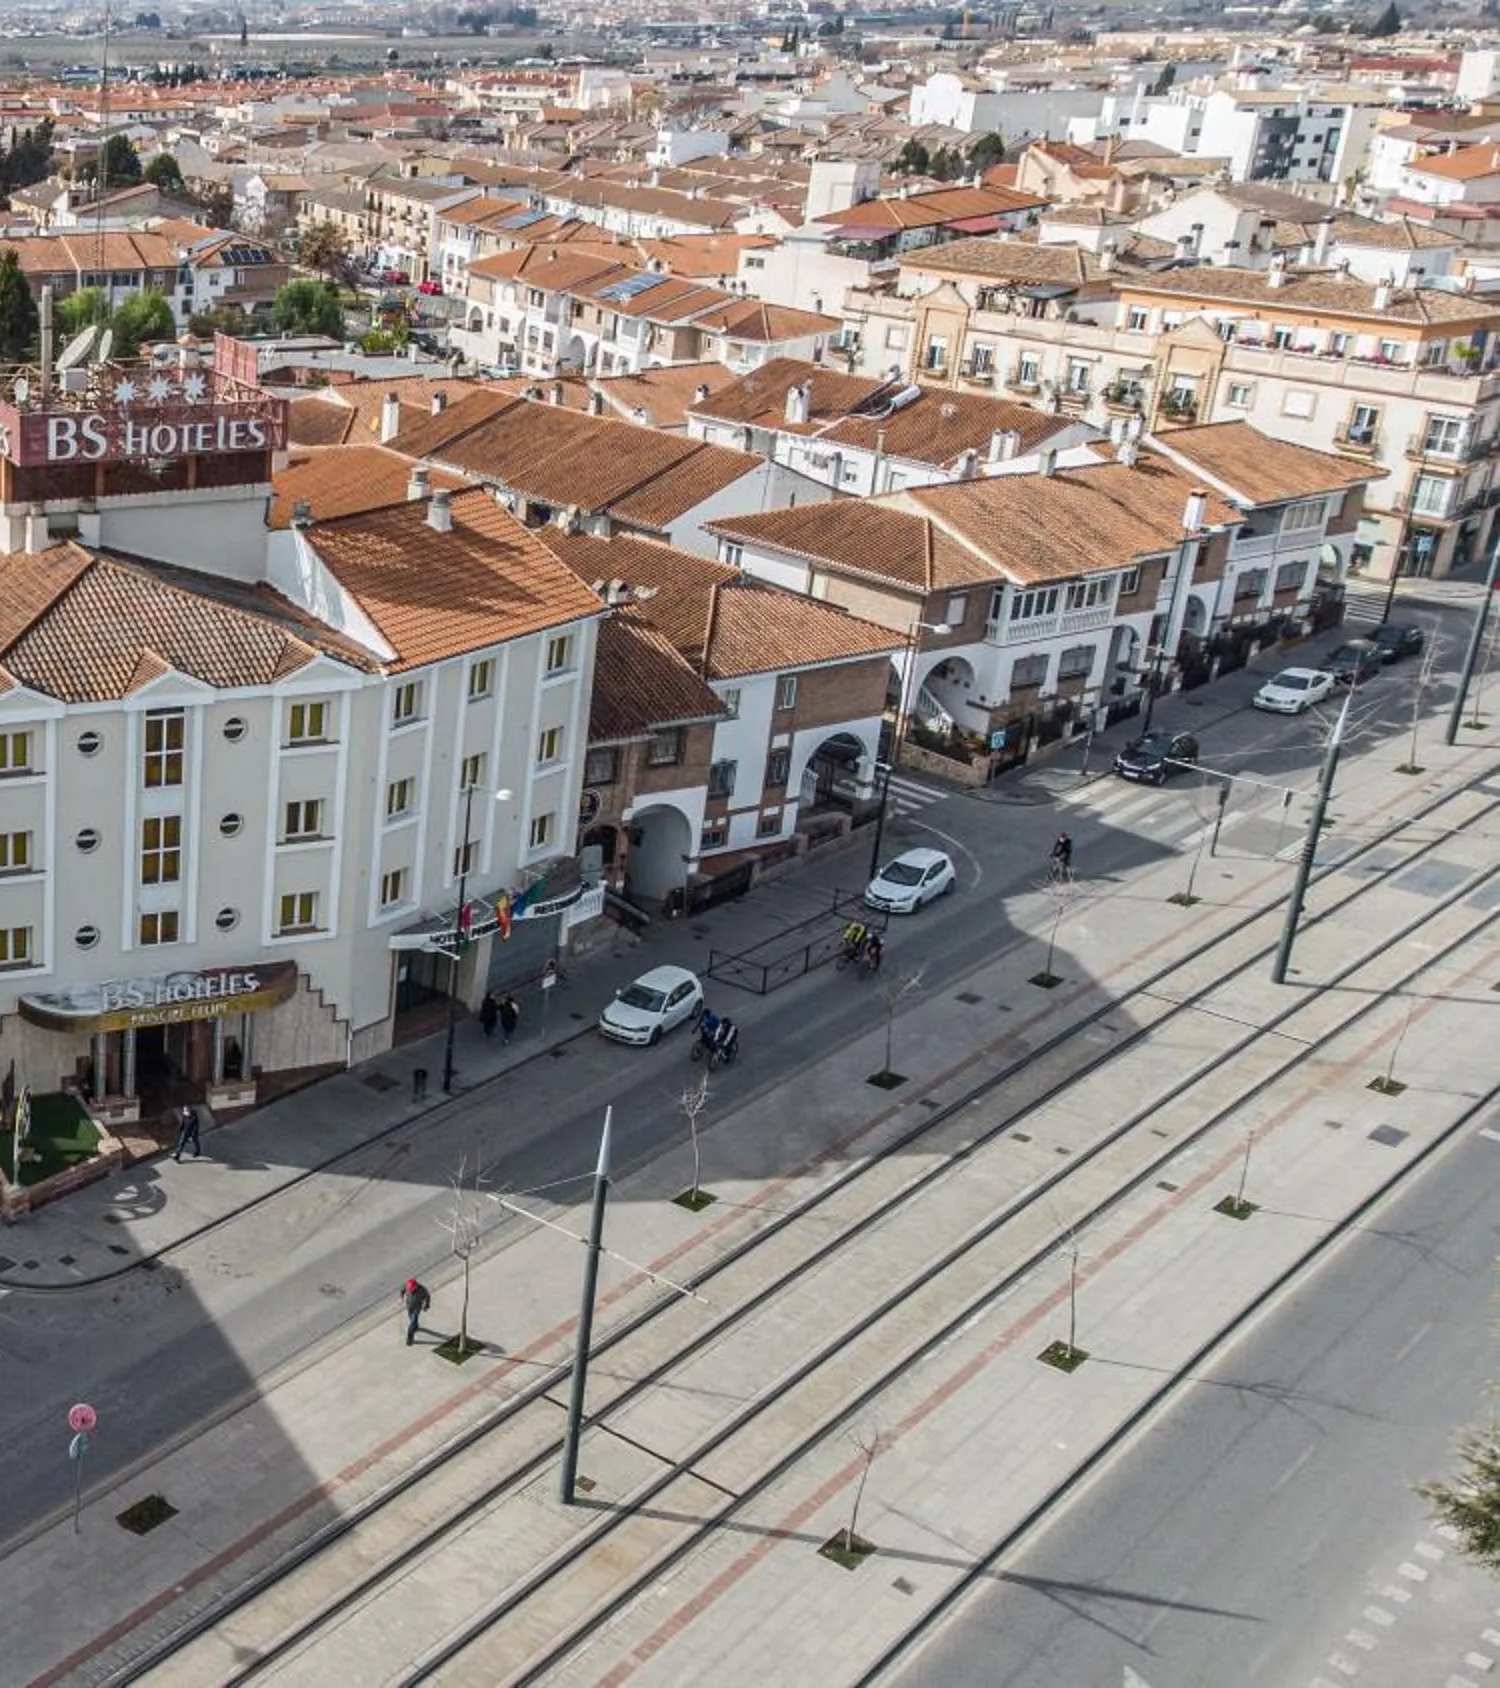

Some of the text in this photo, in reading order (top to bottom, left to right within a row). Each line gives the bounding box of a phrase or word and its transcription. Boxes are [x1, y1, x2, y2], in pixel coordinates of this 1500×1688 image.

[47, 414, 266, 461] BS HOTELES
[102, 972, 261, 1012] BS HOTELES
